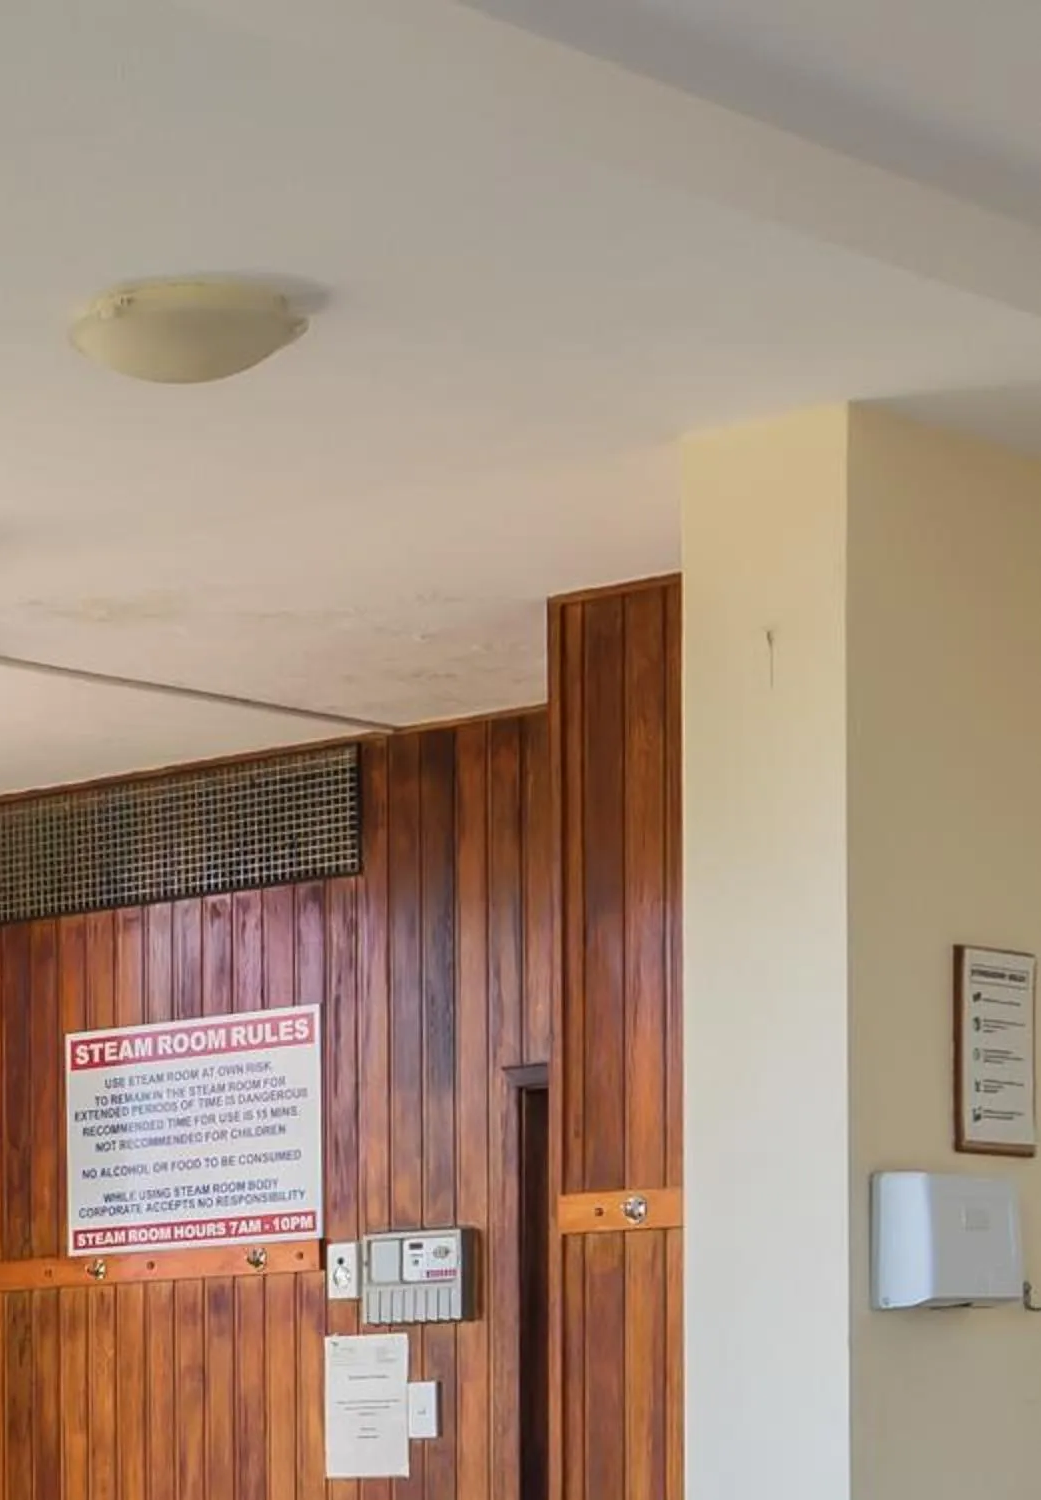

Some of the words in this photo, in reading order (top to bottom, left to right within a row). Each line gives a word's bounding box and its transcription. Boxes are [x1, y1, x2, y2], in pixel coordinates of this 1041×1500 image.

[76, 1038, 153, 1065] STEAM
[158, 1028, 226, 1055] ROOM
[231, 1018, 309, 1047] RULES
[105, 1077, 126, 1089] USE
[128, 1073, 164, 1086] STEAM
[167, 1069, 199, 1081] ROOM
[202, 1067, 214, 1078] AT
[217, 1064, 244, 1077] OWN
[246, 1061, 271, 1073] RISK
[74, 1106, 129, 1121] EXTENDED
[131, 1101, 177, 1116] PERIODS
[180, 1098, 193, 1110] OF
[198, 1095, 223, 1108] TIME
[225, 1094, 235, 1105] IS
[238, 1087, 308, 1105] DANGEROUS
[95, 1095, 108, 1107] TO
[111, 1091, 150, 1105] REMAIN
[153, 1089, 163, 1099] IN
[166, 1086, 185, 1098] THE
[189, 1083, 225, 1097] STEAM
[228, 1079, 261, 1092] ROOM
[263, 1076, 286, 1089] FOR
[82, 1119, 164, 1137] RECOMMENDED
[168, 1115, 191, 1128] TIME
[194, 1113, 216, 1126] FOR
[218, 1110, 240, 1123] USE
[243, 1109, 253, 1121] IS
[270, 1105, 298, 1117] MINS
[95, 1140, 116, 1152] NOT
[119, 1131, 203, 1150] RECOMMENDED
[205, 1128, 228, 1142] FOR
[230, 1123, 286, 1139] CHILDREN
[82, 1168, 98, 1179] NO
[101, 1163, 150, 1178] ALCOHOL
[153, 1161, 168, 1173] OR
[171, 1157, 201, 1172] FOOD
[204, 1156, 219, 1169] TO
[221, 1155, 236, 1167] BE
[239, 1149, 302, 1165] CONSUMED
[79, 1202, 143, 1219] CORPORATE
[146, 1198, 195, 1213] ACCEPTS
[198, 1196, 213, 1208] NO
[216, 1188, 306, 1207] RESPONSIBILITY
[103, 1190, 137, 1203] WHILE
[139, 1187, 171, 1201] USING
[174, 1184, 210, 1198] STEAM
[213, 1180, 245, 1193] ROOM
[247, 1178, 279, 1191] BODY
[77, 1229, 126, 1247] STEAM
[128, 1226, 172, 1243] ROOM
[174, 1220, 226, 1239] HOURS
[228, 1218, 261, 1234] 7AM
[272, 1214, 314, 1231] 10PM
